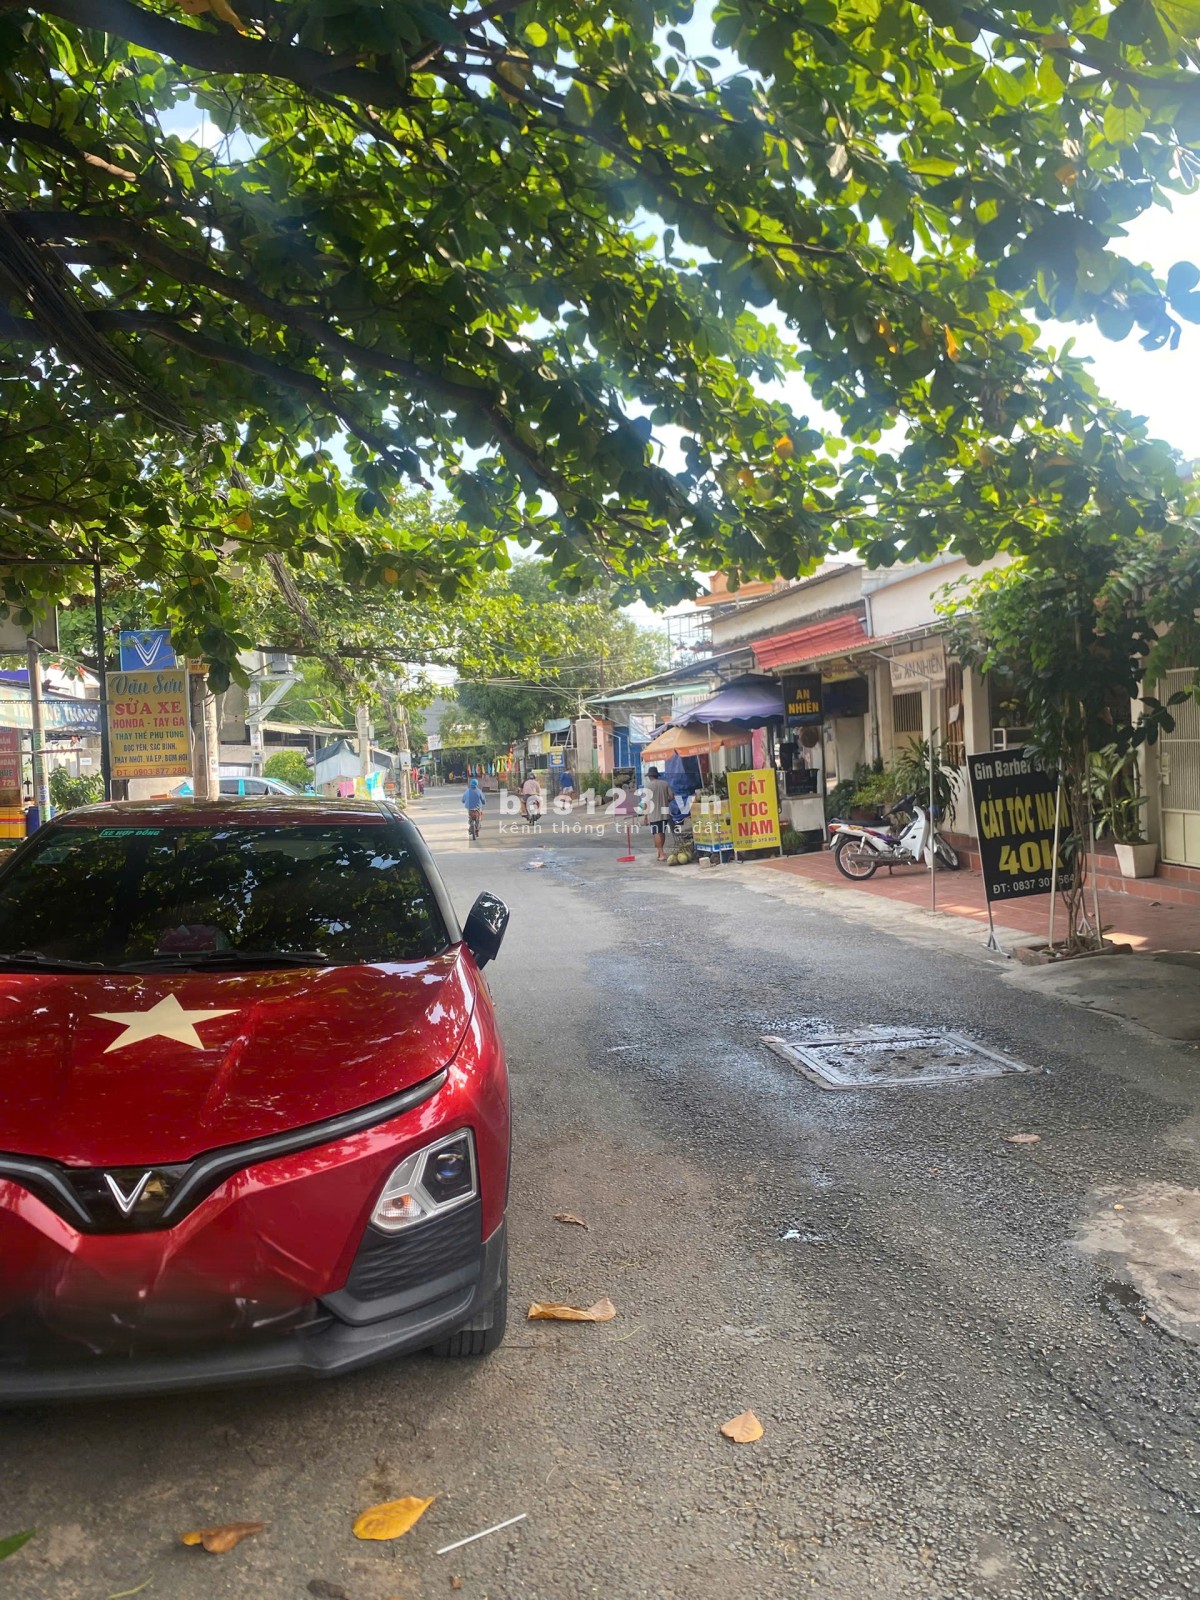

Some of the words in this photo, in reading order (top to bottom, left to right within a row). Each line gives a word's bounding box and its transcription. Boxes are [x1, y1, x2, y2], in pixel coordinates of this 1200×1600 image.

[796, 688, 810, 700] AN
[115, 698, 152, 715] SỬA
[157, 701, 182, 714] XE
[788, 700, 819, 715] NHIÊN
[113, 718, 144, 729] HONDA
[153, 717, 169, 727] TAY
[172, 717, 185, 726] GA
[115, 732, 133, 740] THAY
[133, 768, 153, 776] 0903
[155, 767, 170, 775] 877
[172, 766, 187, 774] 280
[974, 761, 993, 781] Gin
[995, 758, 1031, 778] Barber
[737, 775, 766, 796] CẮT
[739, 800, 768, 818] TÓC
[980, 784, 1005, 840] CẮT
[1006, 787, 1035, 835] TÓC
[1035, 790, 1070, 831] NAM
[737, 819, 773, 837] NAM
[999, 838, 1064, 875] 40K
[993, 883, 1011, 894] ĐT:
[1013, 879, 1036, 892] 0837
[1039, 876, 1054, 888] 30
